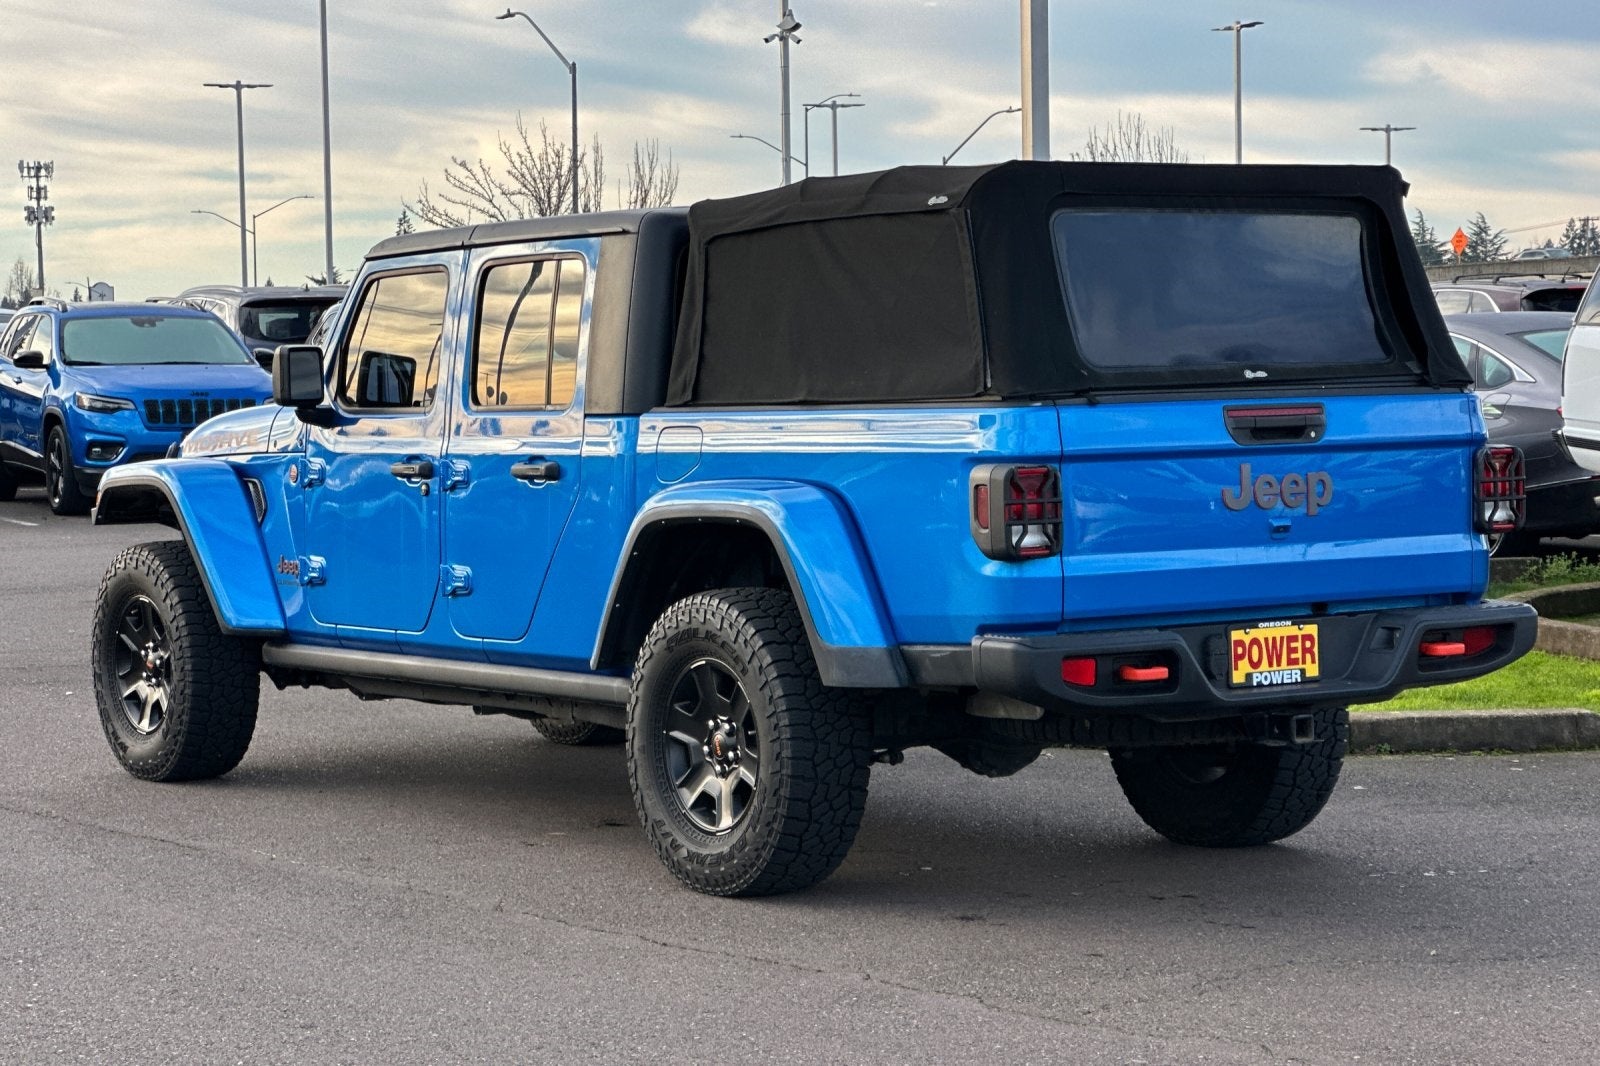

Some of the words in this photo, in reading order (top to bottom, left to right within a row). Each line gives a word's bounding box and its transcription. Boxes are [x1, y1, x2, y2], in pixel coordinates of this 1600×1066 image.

[1222, 463, 1333, 517] Jeep
[277, 555, 300, 580] Jeep
[1233, 633, 1316, 671] POWER
[1252, 669, 1301, 686] POWER
